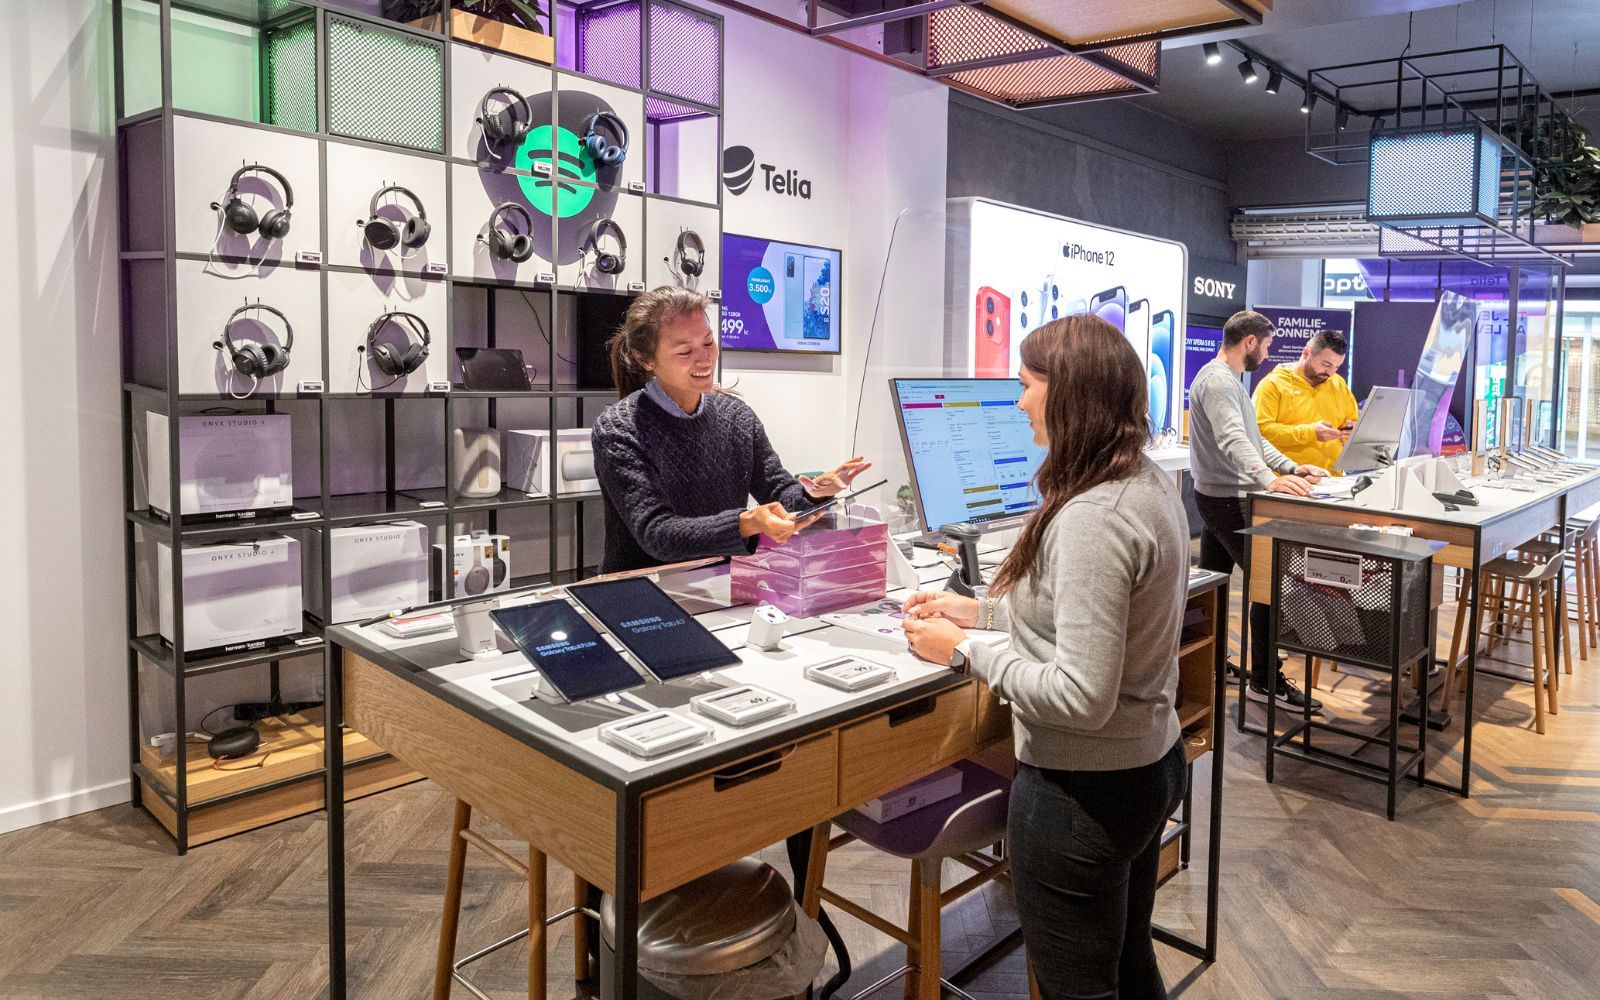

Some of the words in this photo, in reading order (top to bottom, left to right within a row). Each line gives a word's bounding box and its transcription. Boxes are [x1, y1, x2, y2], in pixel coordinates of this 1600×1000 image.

[760, 163, 811, 200] Telia
[1070, 243, 1104, 264] iPhone
[1105, 251, 1115, 266] 12
[749, 283, 769, 293] 3.500
[1194, 276, 1236, 299] SONY
[721, 318, 744, 335] 499
[1278, 317, 1326, 328] FAMILIE-
[354, 536, 373, 544] ONYX
[211, 554, 234, 562] ONYX
[237, 550, 267, 559] STUDIO
[620, 616, 663, 628] SAMSUNG
[631, 622, 662, 634] Galaxy
[660, 620, 676, 629] Tab
[535, 641, 570, 652] SAMSUNG
[540, 647, 566, 657] Galaxy
